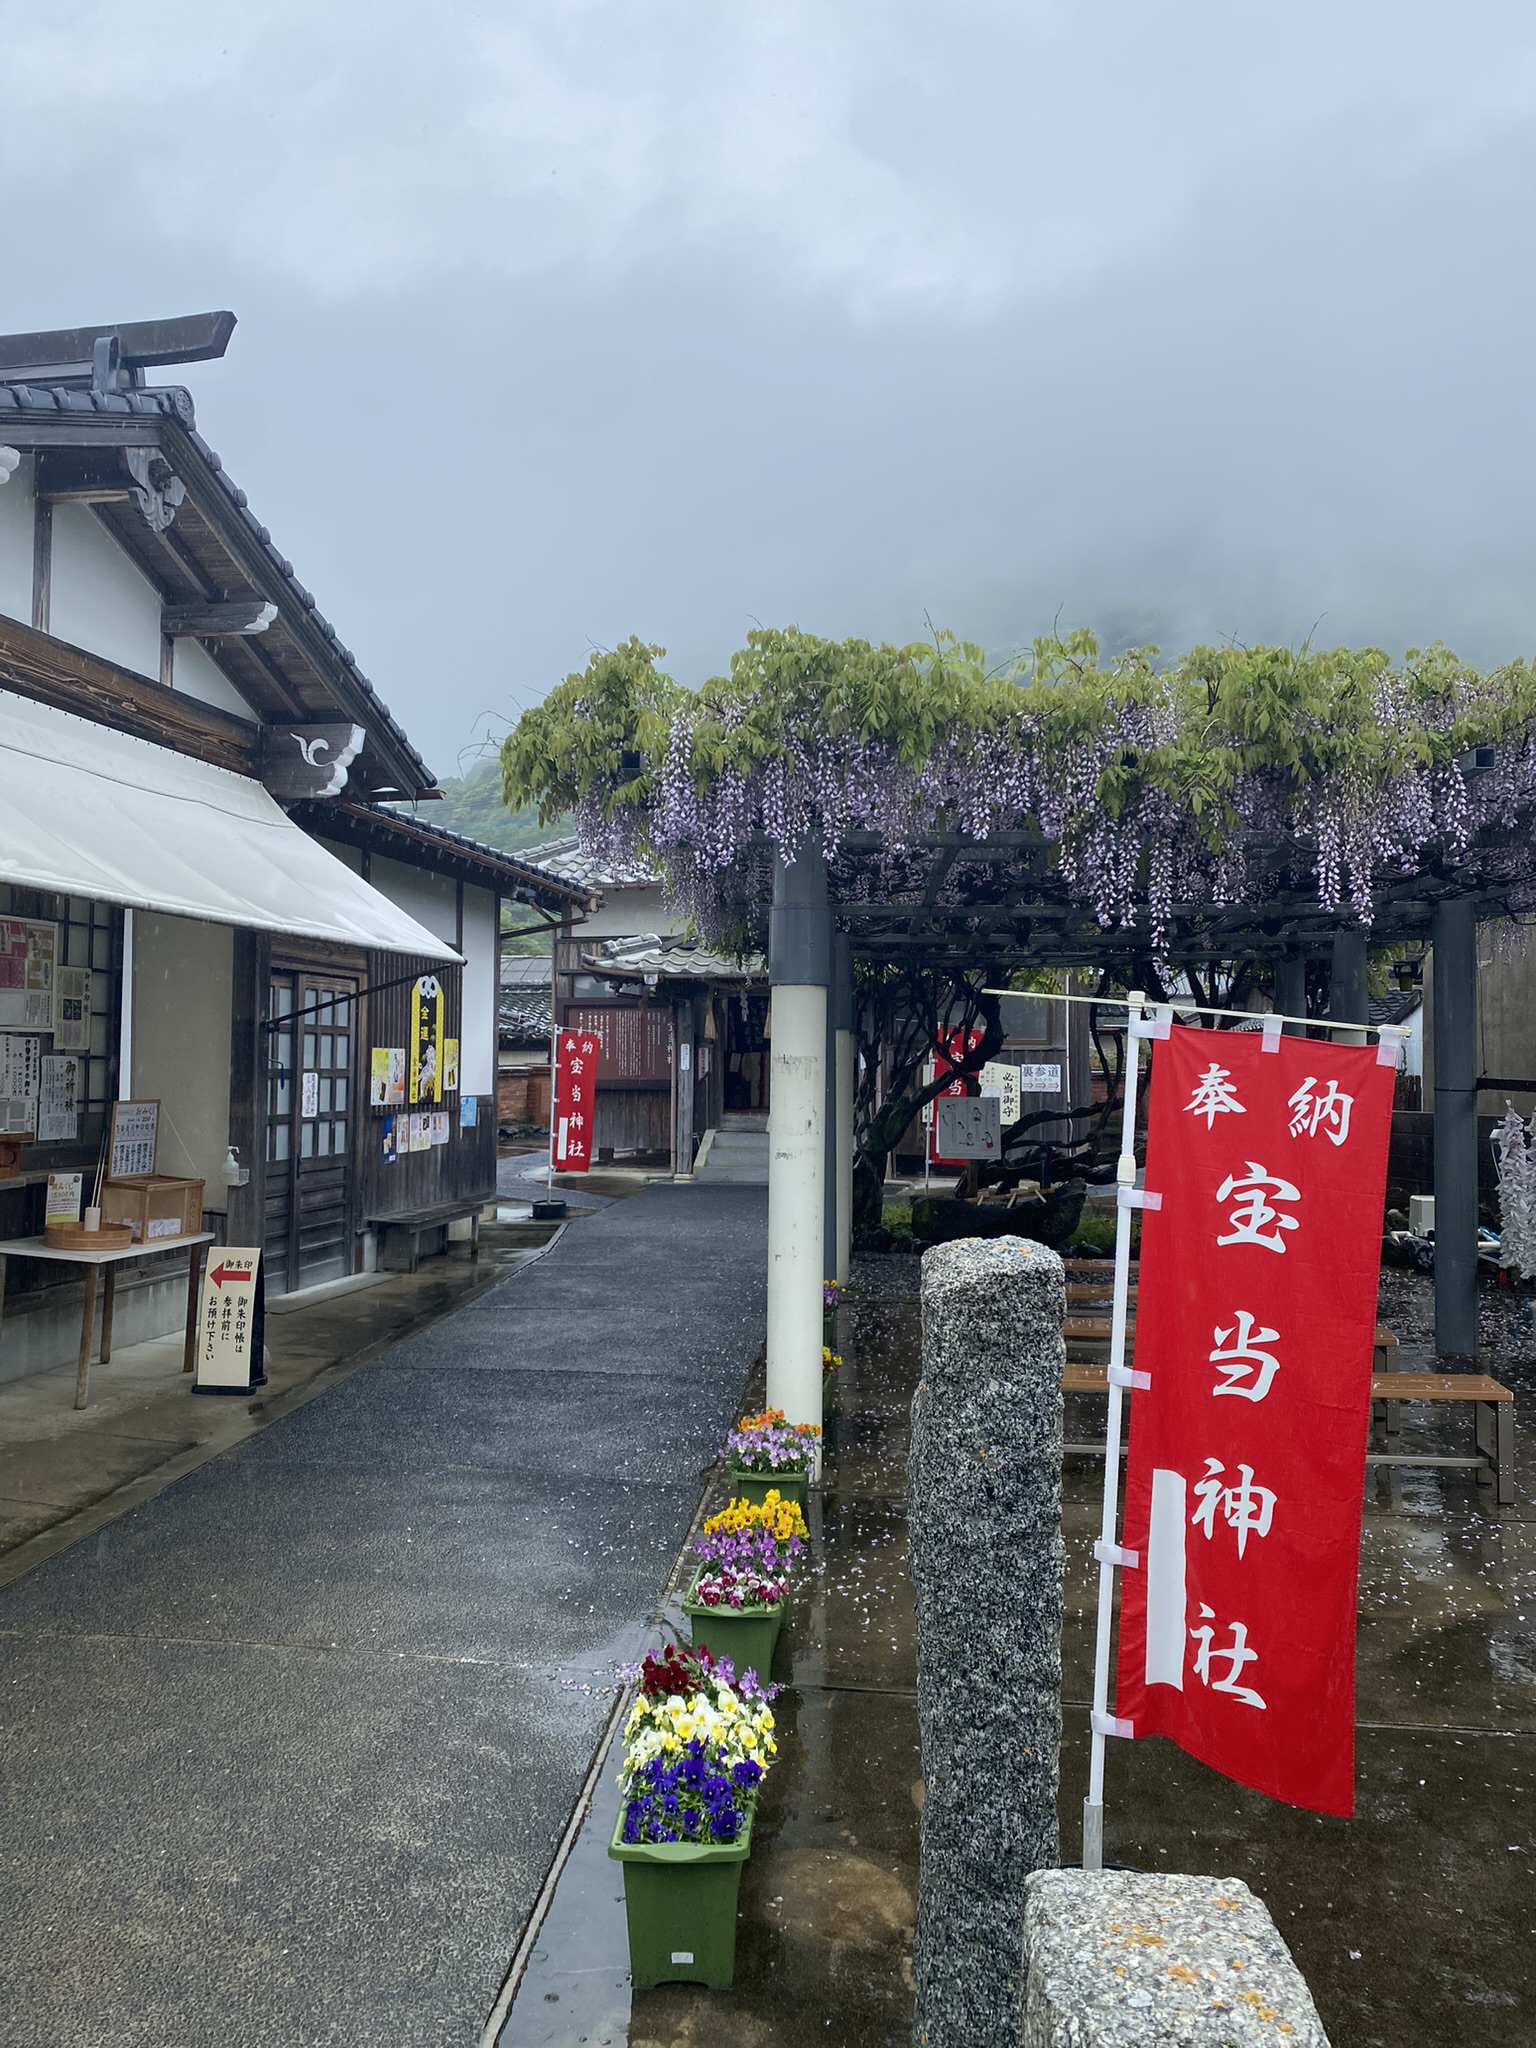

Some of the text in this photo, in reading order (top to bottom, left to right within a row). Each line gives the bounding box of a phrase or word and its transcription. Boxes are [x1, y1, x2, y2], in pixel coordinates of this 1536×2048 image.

[565, 1038, 594, 1054] 奉納
[1002, 1072, 1014, 1117] 必当御守
[1022, 1065, 1060, 1078] 裏参道
[135, 1107, 156, 1116] おみくじ
[568, 1057, 585, 1157] 宝当神社
[1183, 1062, 1355, 1147] 奉納
[225, 1259, 253, 1270] 御朱印
[205, 1296, 218, 1361] お預け下さい
[221, 1295, 233, 1341] 参拝前に
[234, 1296, 249, 1353] 御朱印帳は
[1188, 1160, 1301, 1711] 宝当神社
